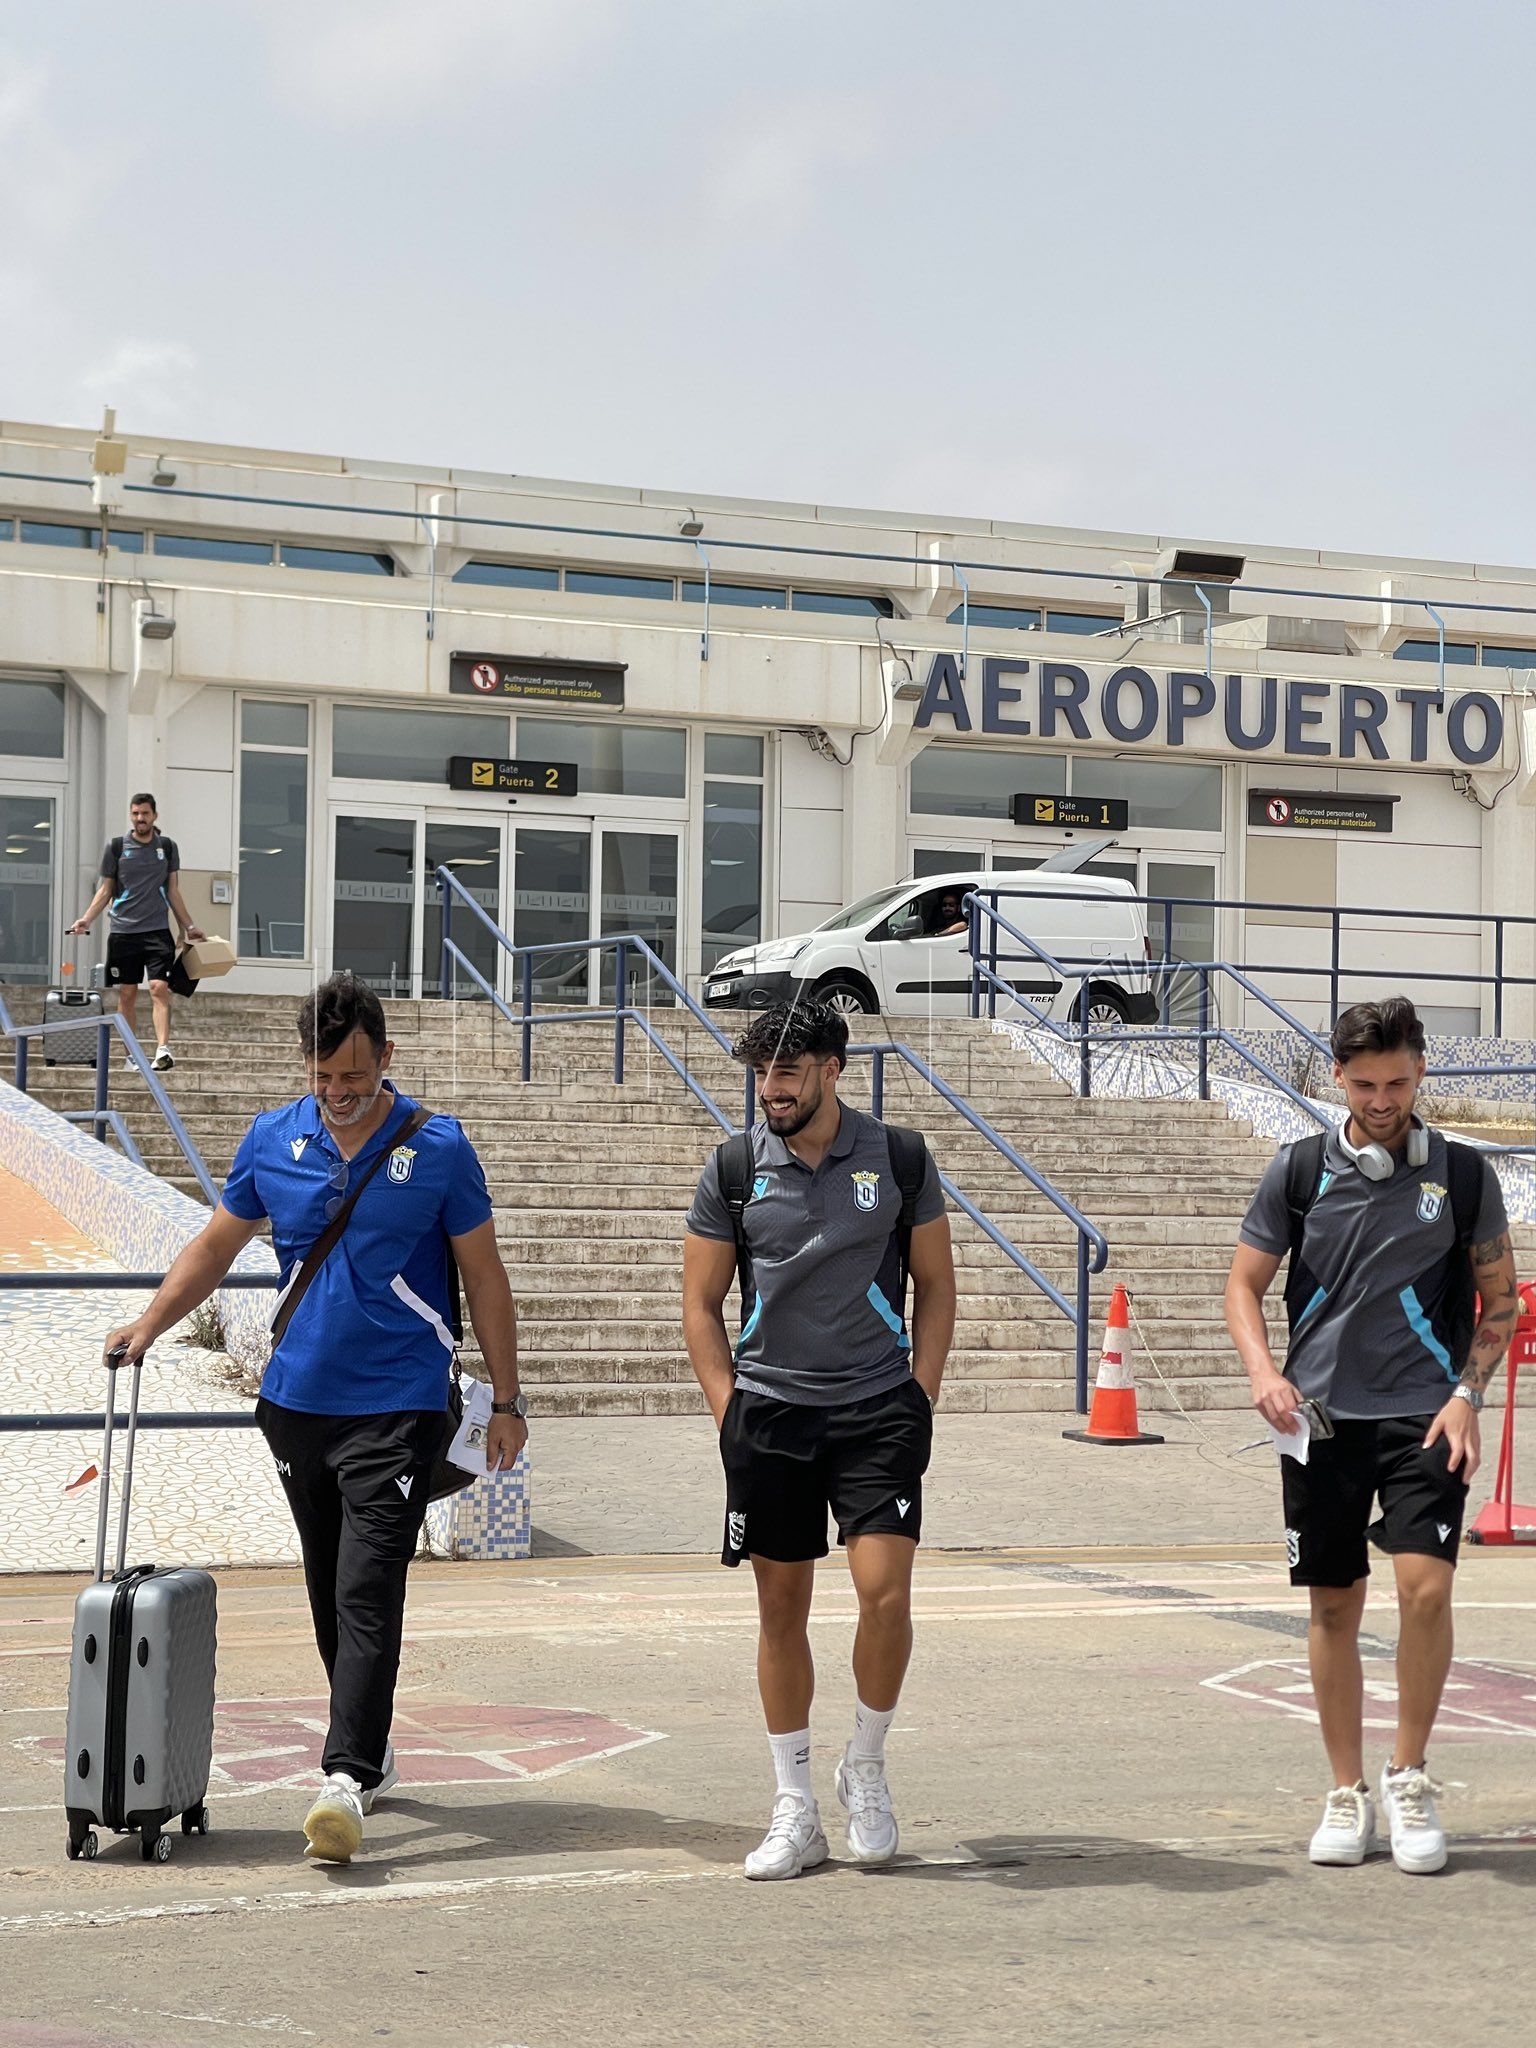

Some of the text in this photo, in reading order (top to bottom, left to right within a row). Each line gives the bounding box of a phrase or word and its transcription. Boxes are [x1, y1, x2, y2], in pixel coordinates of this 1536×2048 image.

[503, 674, 593, 690] Authorized personnel only
[503, 683, 602, 698] Sólo personal autorizado
[915, 654, 1503, 765] AEROPUERTO
[499, 764, 519, 774] Gate
[499, 768, 558, 789] Puerta 2
[1059, 801, 1076, 811] Gate
[1059, 805, 1110, 824] Puerta 1
[1294, 807, 1368, 820] Authorized personnel only
[1294, 815, 1377, 828] Sólo personal autorizado
[1030, 995, 1055, 1003] TREK
